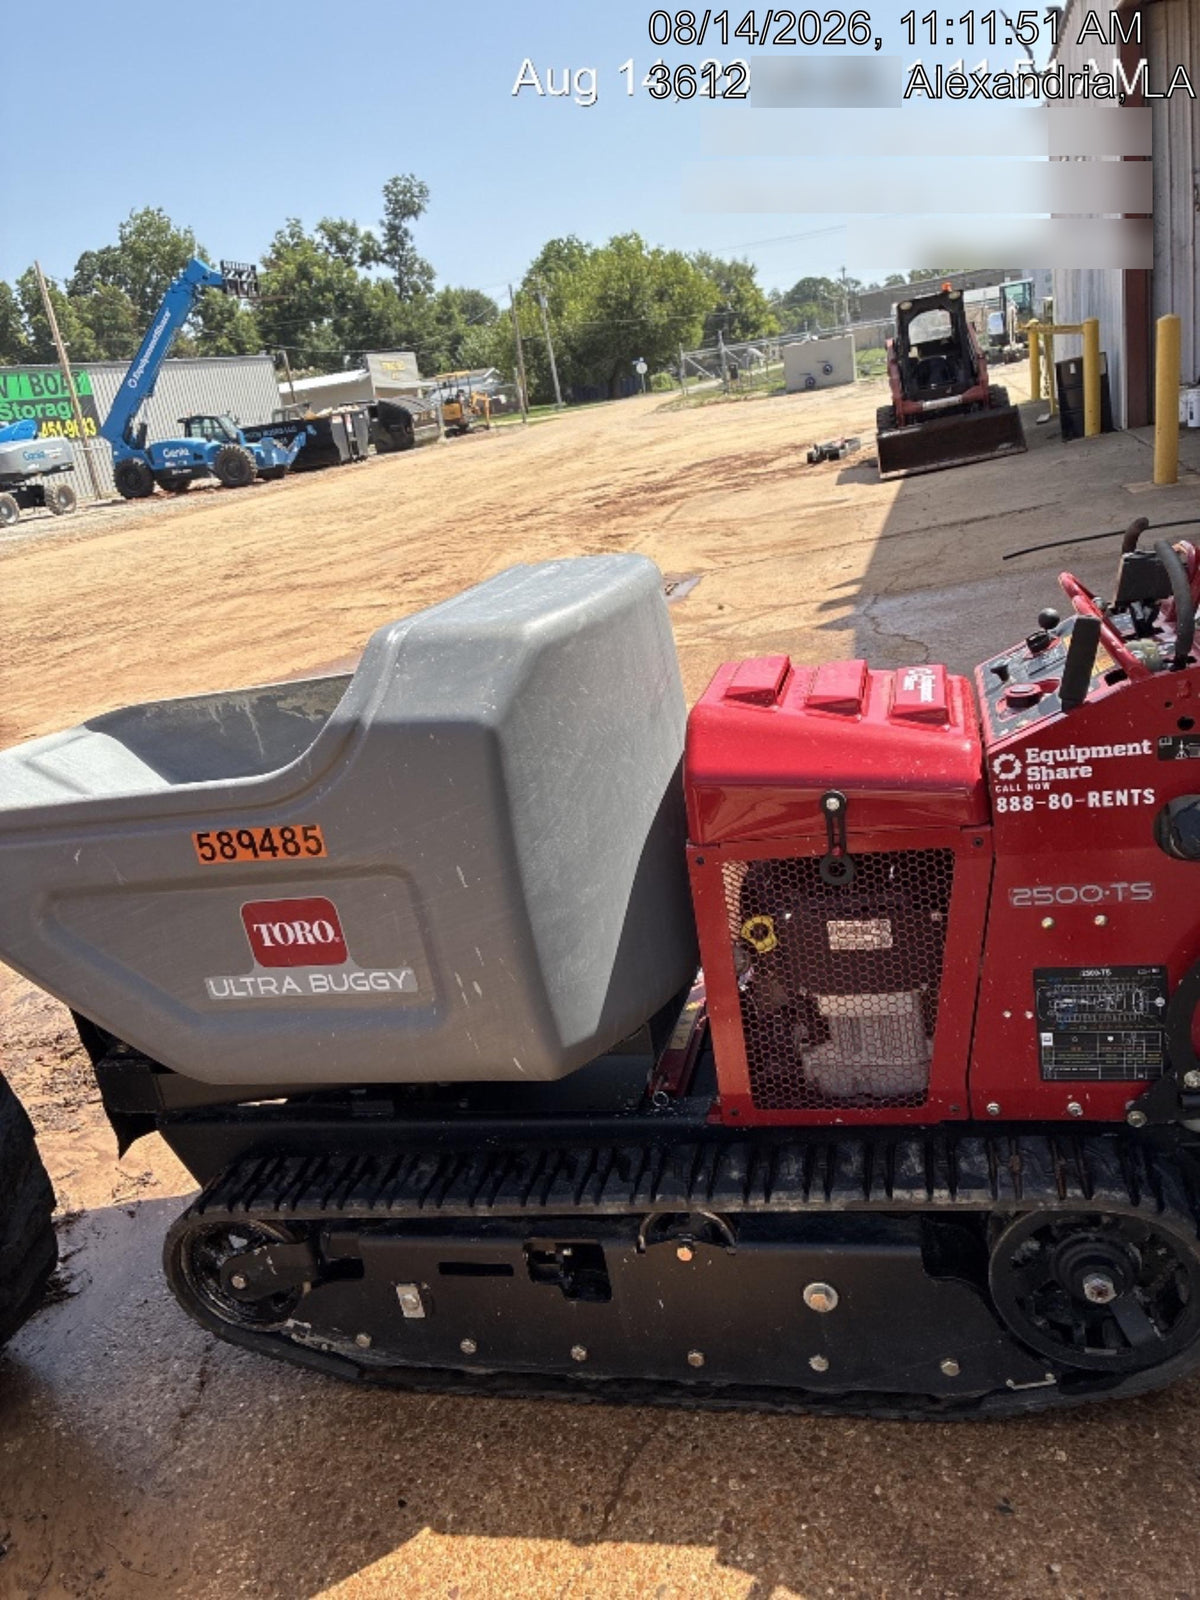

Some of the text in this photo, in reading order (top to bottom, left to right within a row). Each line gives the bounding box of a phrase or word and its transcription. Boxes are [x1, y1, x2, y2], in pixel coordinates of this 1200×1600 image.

[0, 401, 74, 420] Storag
[1026, 739, 1152, 765] Equipment
[1027, 764, 1093, 782] Share
[995, 781, 1051, 793] CALL NOW
[996, 788, 1155, 813] 888-80-RENTS
[196, 824, 324, 861] 589485
[253, 920, 337, 946] TORO
[208, 971, 409, 997] ULTRA BUGGY
